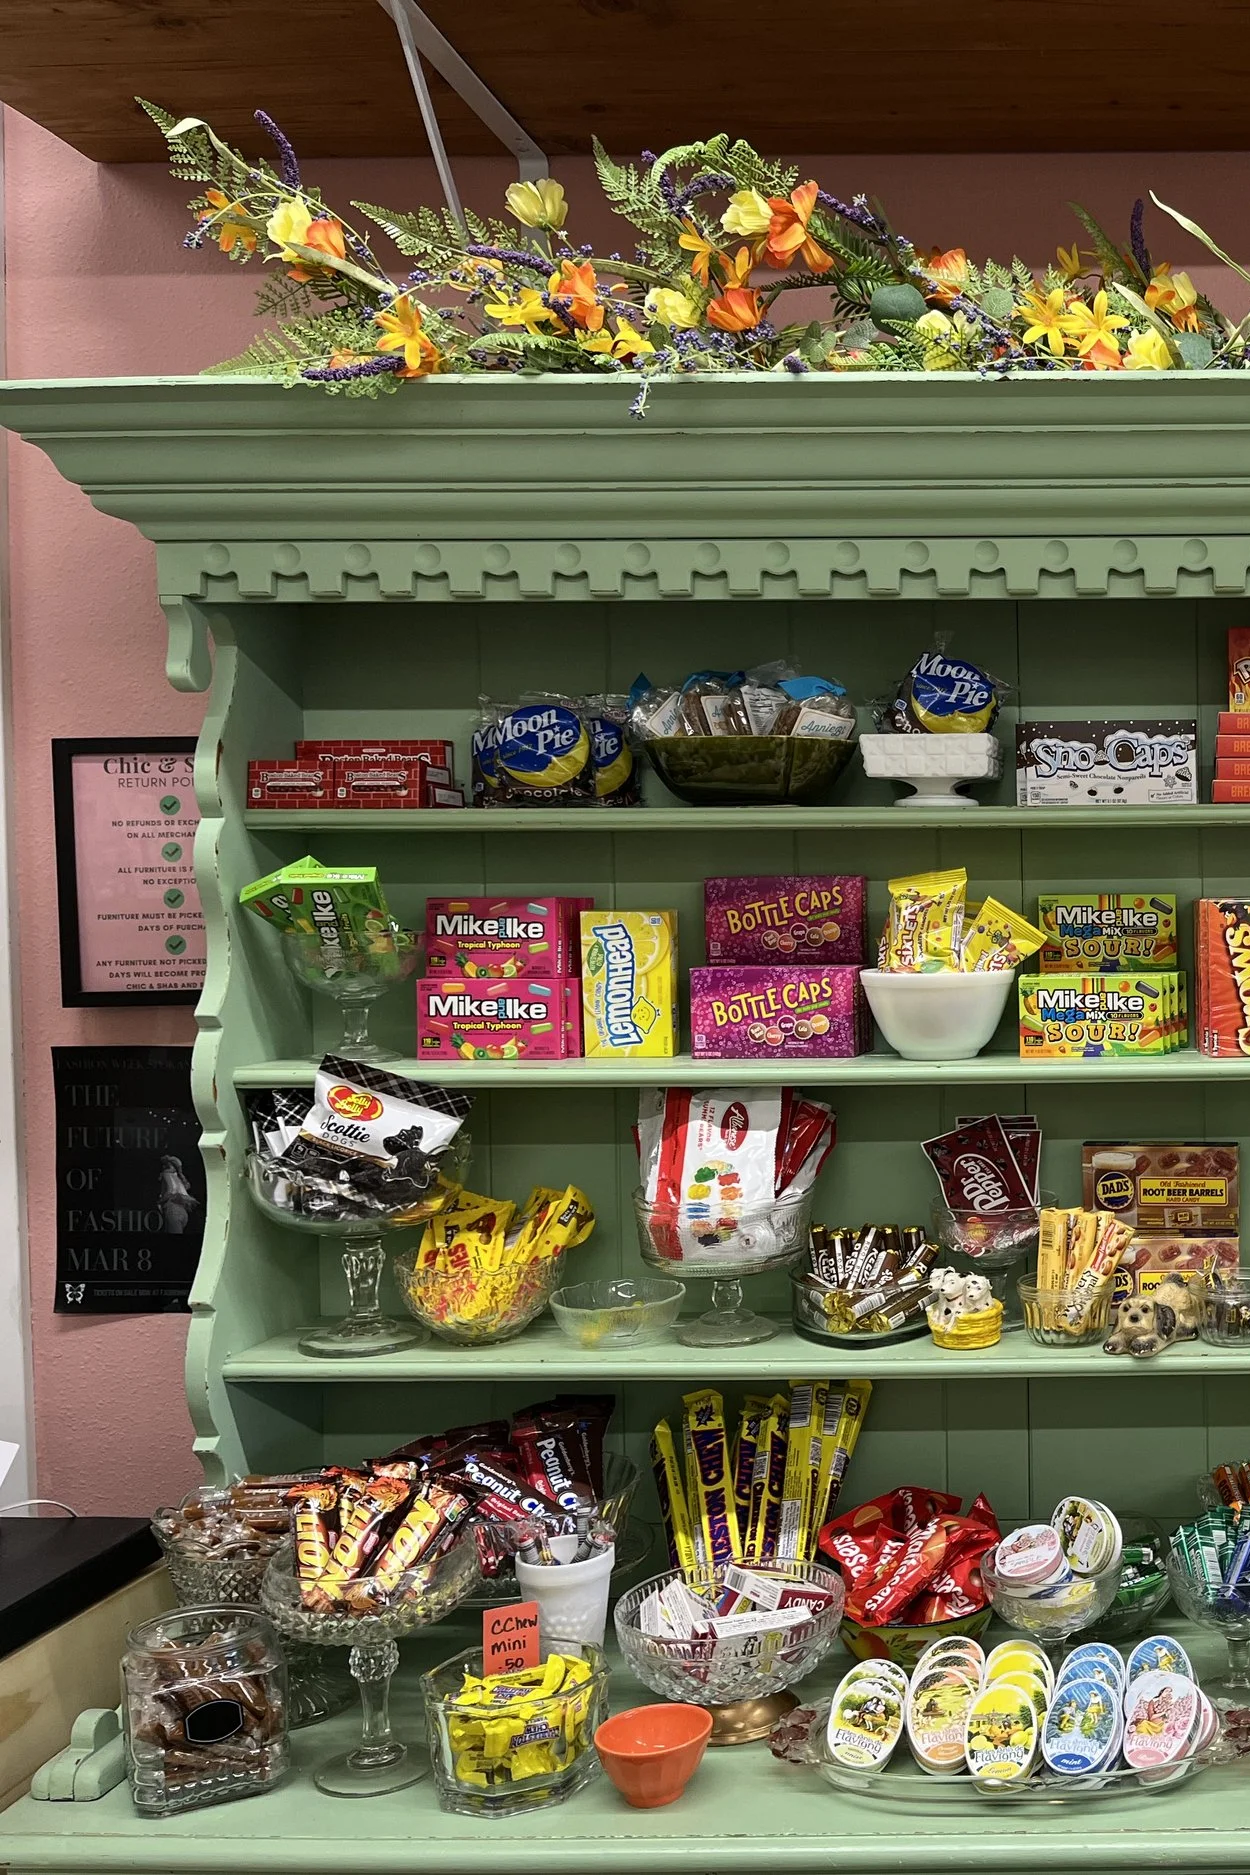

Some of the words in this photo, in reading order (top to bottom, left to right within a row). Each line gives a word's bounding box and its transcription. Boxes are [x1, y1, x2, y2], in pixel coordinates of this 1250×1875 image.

[945, 680, 989, 706] Pie
[494, 709, 558, 745] Moon
[536, 725, 574, 756] Pie
[104, 757, 151, 774] Chic
[159, 757, 177, 773] &
[1035, 743, 1095, 778] Sno
[1107, 738, 1188, 778] Caps
[118, 777, 167, 788] RETURN
[1117, 773, 1147, 781] Nonpareils
[312, 890, 338, 922] Ike
[726, 896, 793, 934] BOTTLE
[795, 886, 843, 917] CAPS
[1056, 906, 1116, 924] Mike
[1115, 909, 1123, 926] and
[1122, 909, 1158, 926] Ike
[437, 915, 499, 936] Mike
[498, 918, 506, 938] and
[505, 917, 544, 939] Ike
[1060, 924, 1101, 938] Mega
[458, 941, 486, 950] Tropical
[487, 941, 521, 950] Typhoon
[1065, 938, 1155, 957] SOUR!
[429, 996, 498, 1016] Mike
[505, 998, 547, 1019] Ike
[711, 988, 781, 1026] BOTTLE
[783, 978, 832, 1009] CAPS
[1037, 989, 1100, 1009] Mike
[1099, 992, 1107, 1010] and
[1106, 992, 1144, 1011] Ike
[453, 1022, 484, 1030] Tropical
[486, 1022, 522, 1030] Typhoon
[1042, 1008, 1085, 1023] Mega
[1047, 1022, 1140, 1043] SOUR!
[65, 1085, 120, 1107] THE
[348, 1093, 372, 1110] Jelly
[335, 1100, 365, 1116] Belly
[67, 1127, 168, 1150] FUTURE
[320, 1114, 371, 1144] Scottie
[322, 1132, 358, 1148] DOGS
[66, 1168, 102, 1190] OF
[961, 1160, 1011, 1212] Pepper
[961, 1177, 986, 1200] Dr
[1101, 1180, 1130, 1196] DAD'S
[1159, 1180, 1171, 1188] Old
[1173, 1180, 1207, 1188] Fashioned
[1142, 1188, 1166, 1197] ROOT
[1166, 1188, 1187, 1197] BEER
[1189, 1188, 1225, 1198] BARRELS
[67, 1248, 130, 1271] MAR
[137, 1248, 153, 1271] 8
[536, 1437, 574, 1494] Peanut
[465, 1462, 522, 1504] Peanut
[865, 1517, 941, 1612] Maltesers
[784, 1594, 826, 1612] CANDY
[498, 1657, 525, 1671] .50
[835, 1729, 883, 1755] Flavigny
[1050, 1737, 1099, 1757] Flavigny
[1060, 1757, 1083, 1766] mint
